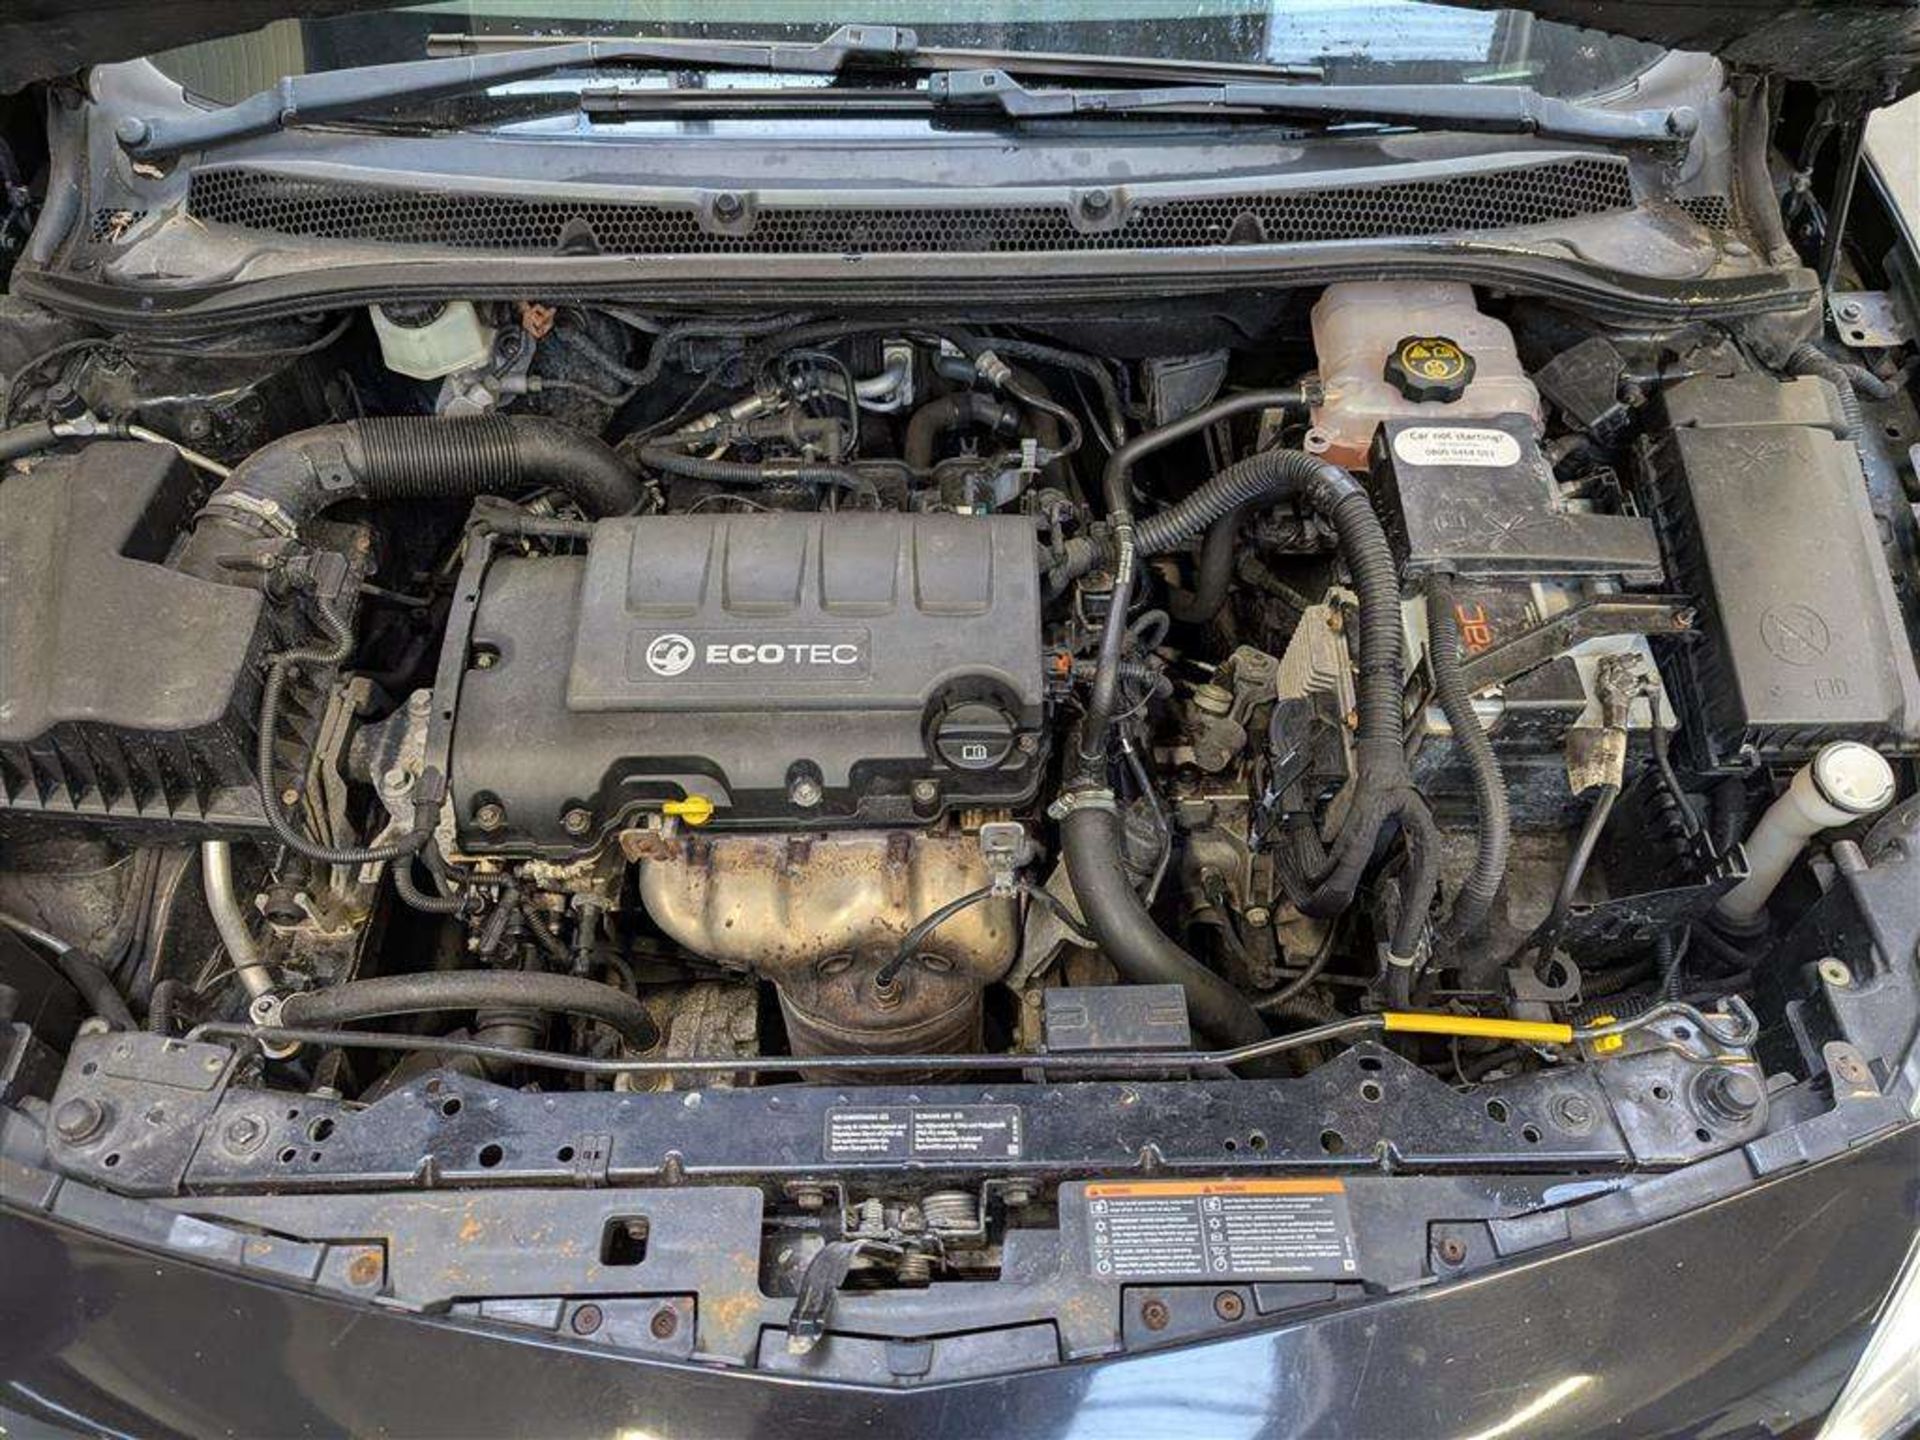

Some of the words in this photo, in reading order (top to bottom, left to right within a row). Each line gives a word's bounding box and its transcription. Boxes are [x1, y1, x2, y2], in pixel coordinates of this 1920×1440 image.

[1409, 430, 1429, 441] Car
[1432, 431, 1453, 441] not
[706, 644, 858, 664] ECOTEC
